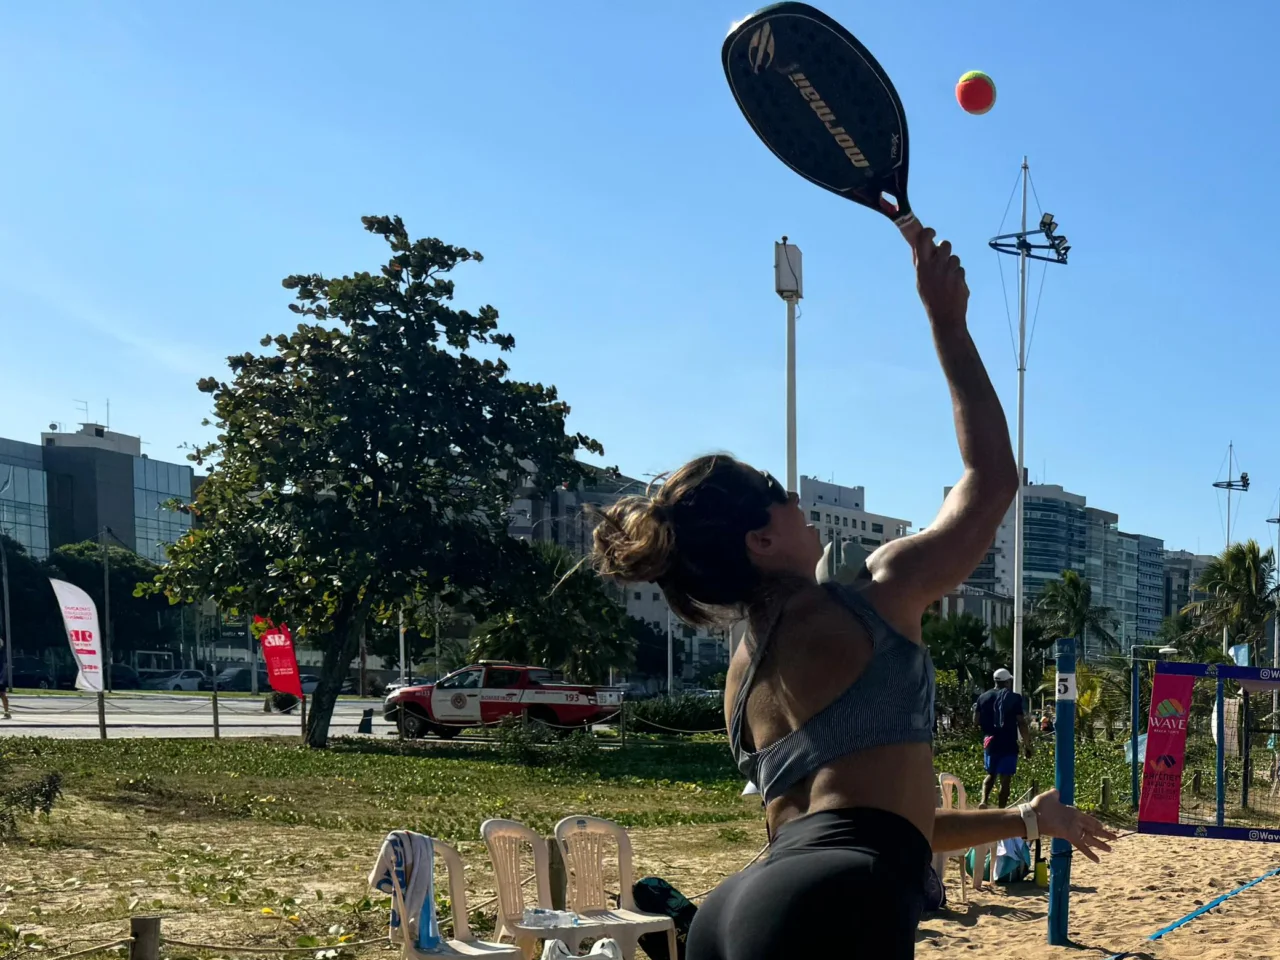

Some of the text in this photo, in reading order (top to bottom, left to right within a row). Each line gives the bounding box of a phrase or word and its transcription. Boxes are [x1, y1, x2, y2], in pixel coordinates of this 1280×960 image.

[788, 73, 870, 168] mormaii
[1058, 677, 1069, 694] 5
[565, 693, 580, 702] 193
[1150, 717, 1186, 730] WAVE
[1144, 773, 1181, 781] partner
